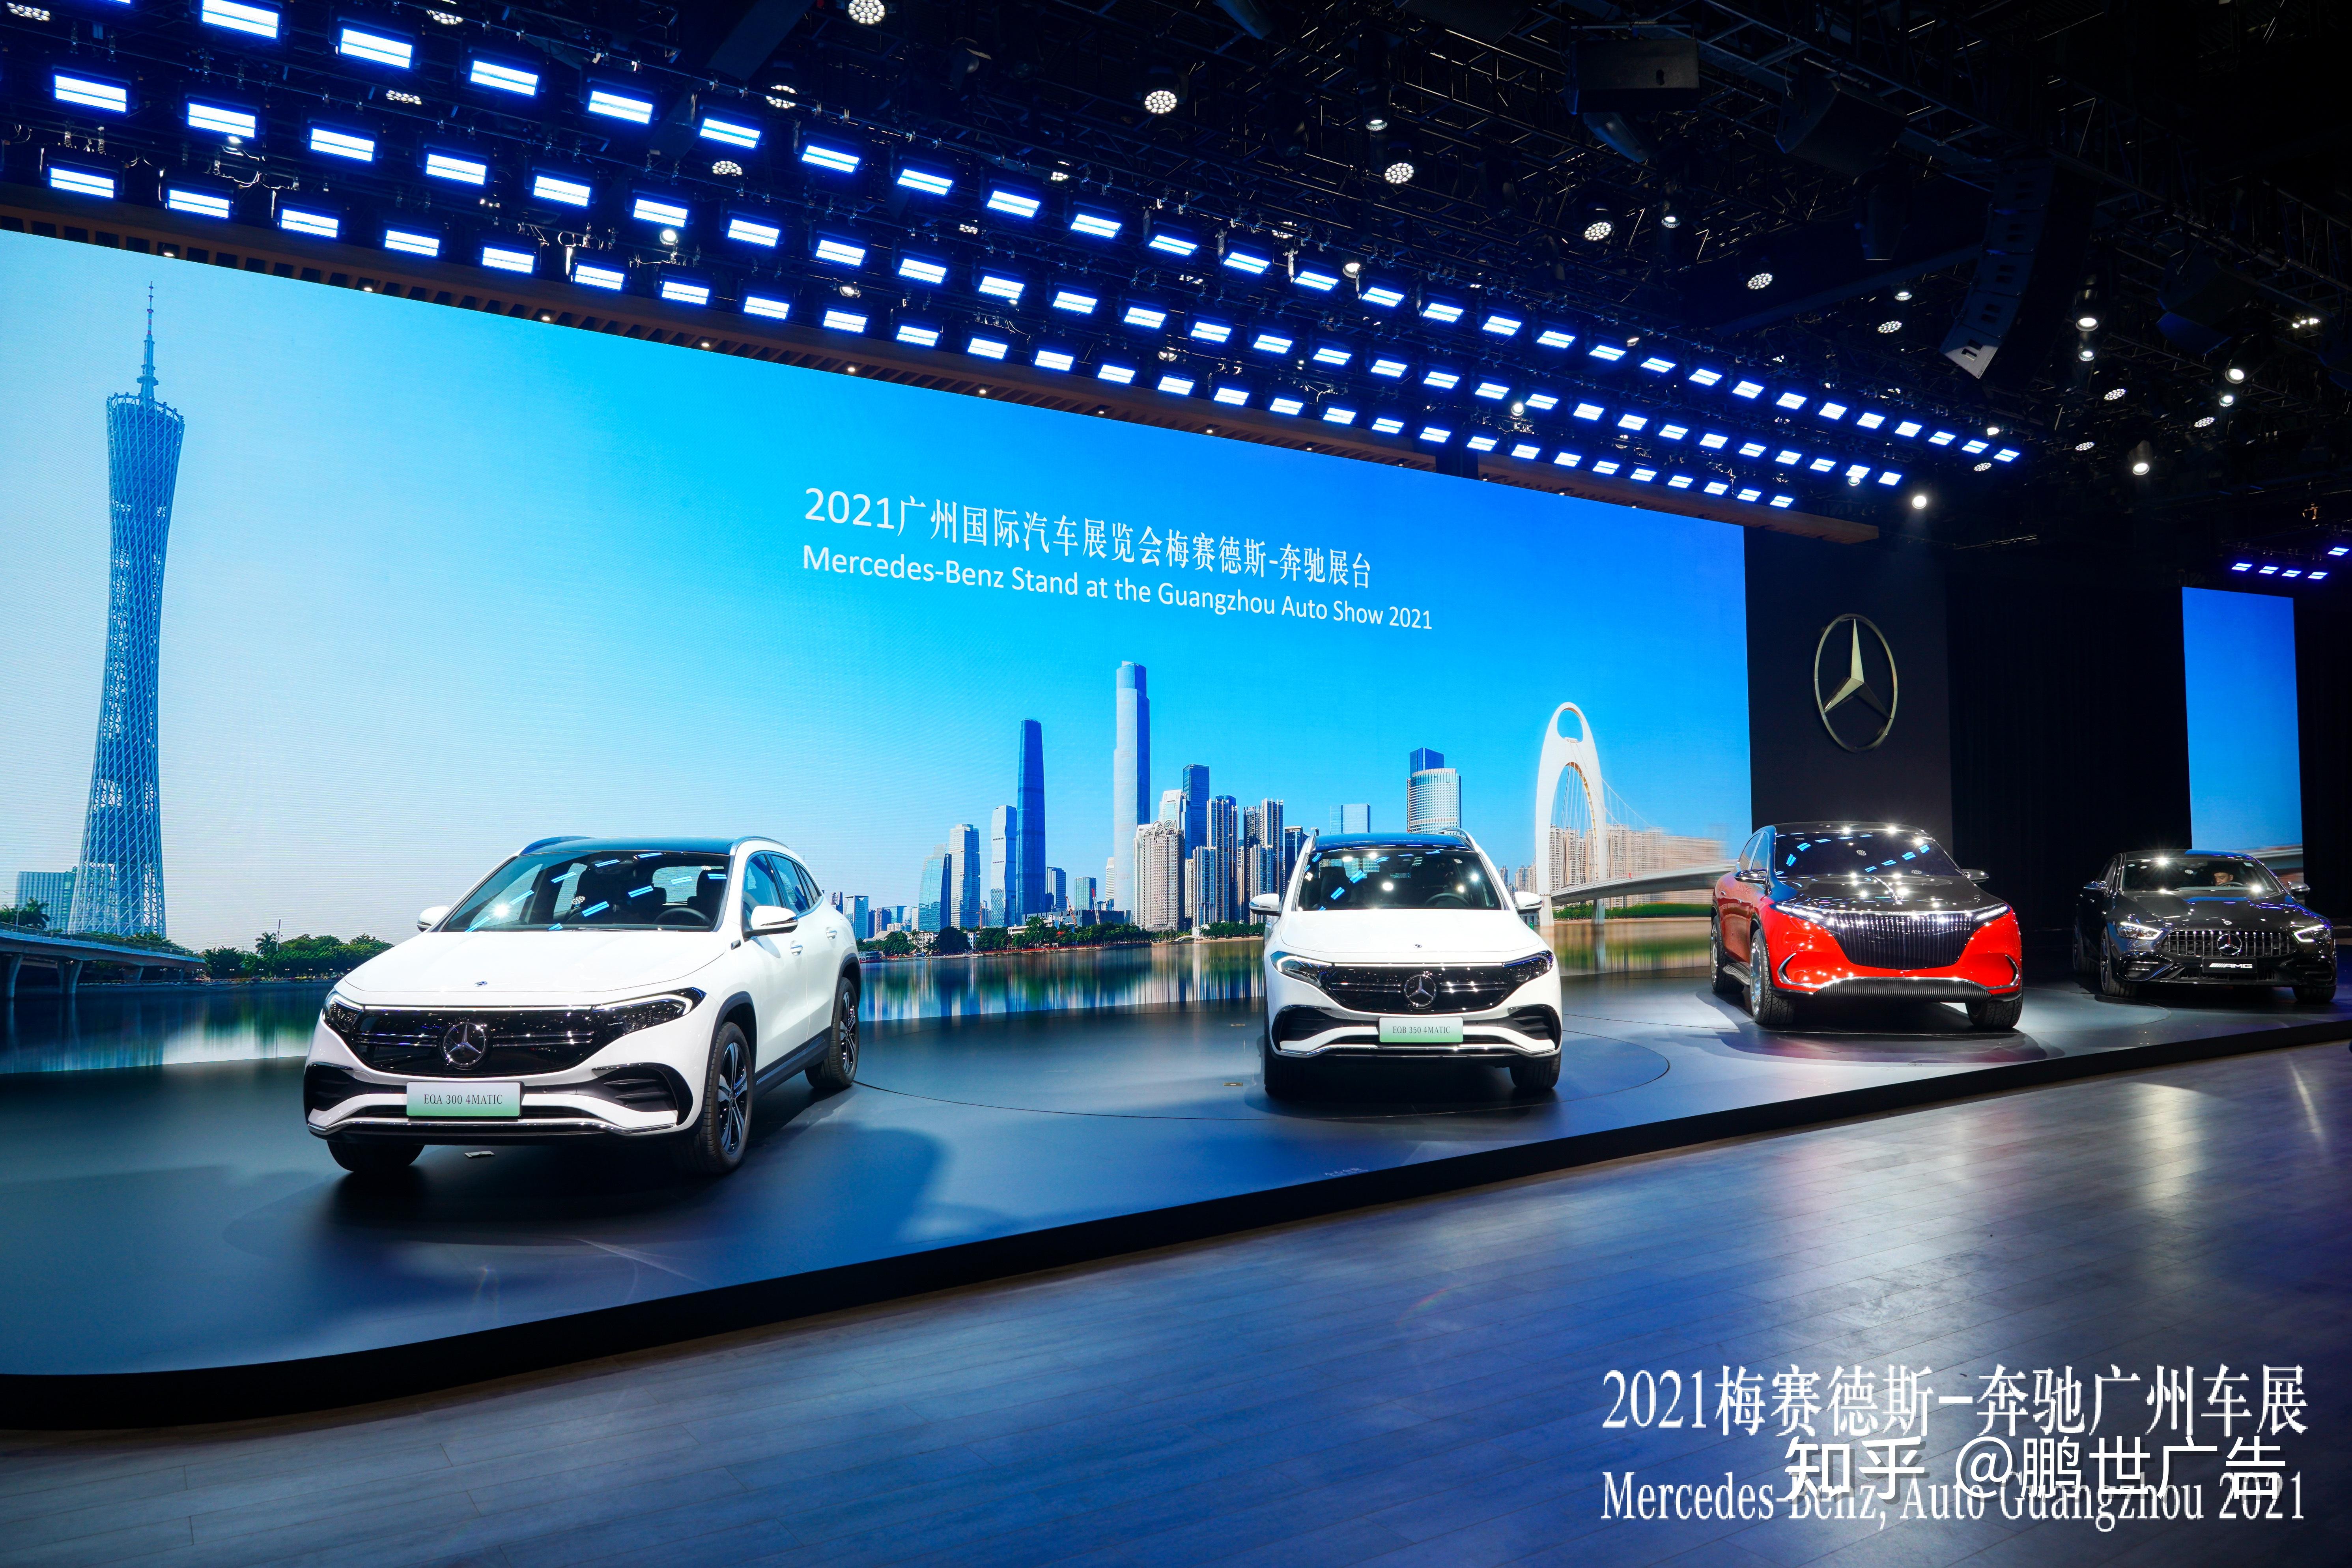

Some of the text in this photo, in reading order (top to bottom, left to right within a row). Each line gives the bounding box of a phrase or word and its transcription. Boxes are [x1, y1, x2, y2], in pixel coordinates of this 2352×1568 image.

[805, 488, 1371, 589] 2021广州国际汽车展览会梅赛德斯-奔驰展台
[803, 545, 1432, 630] Mercedes-Benz Stand at the Guangzhou Auto Show 2021
[424, 1094, 503, 1105] EQA 300 4MATIC
